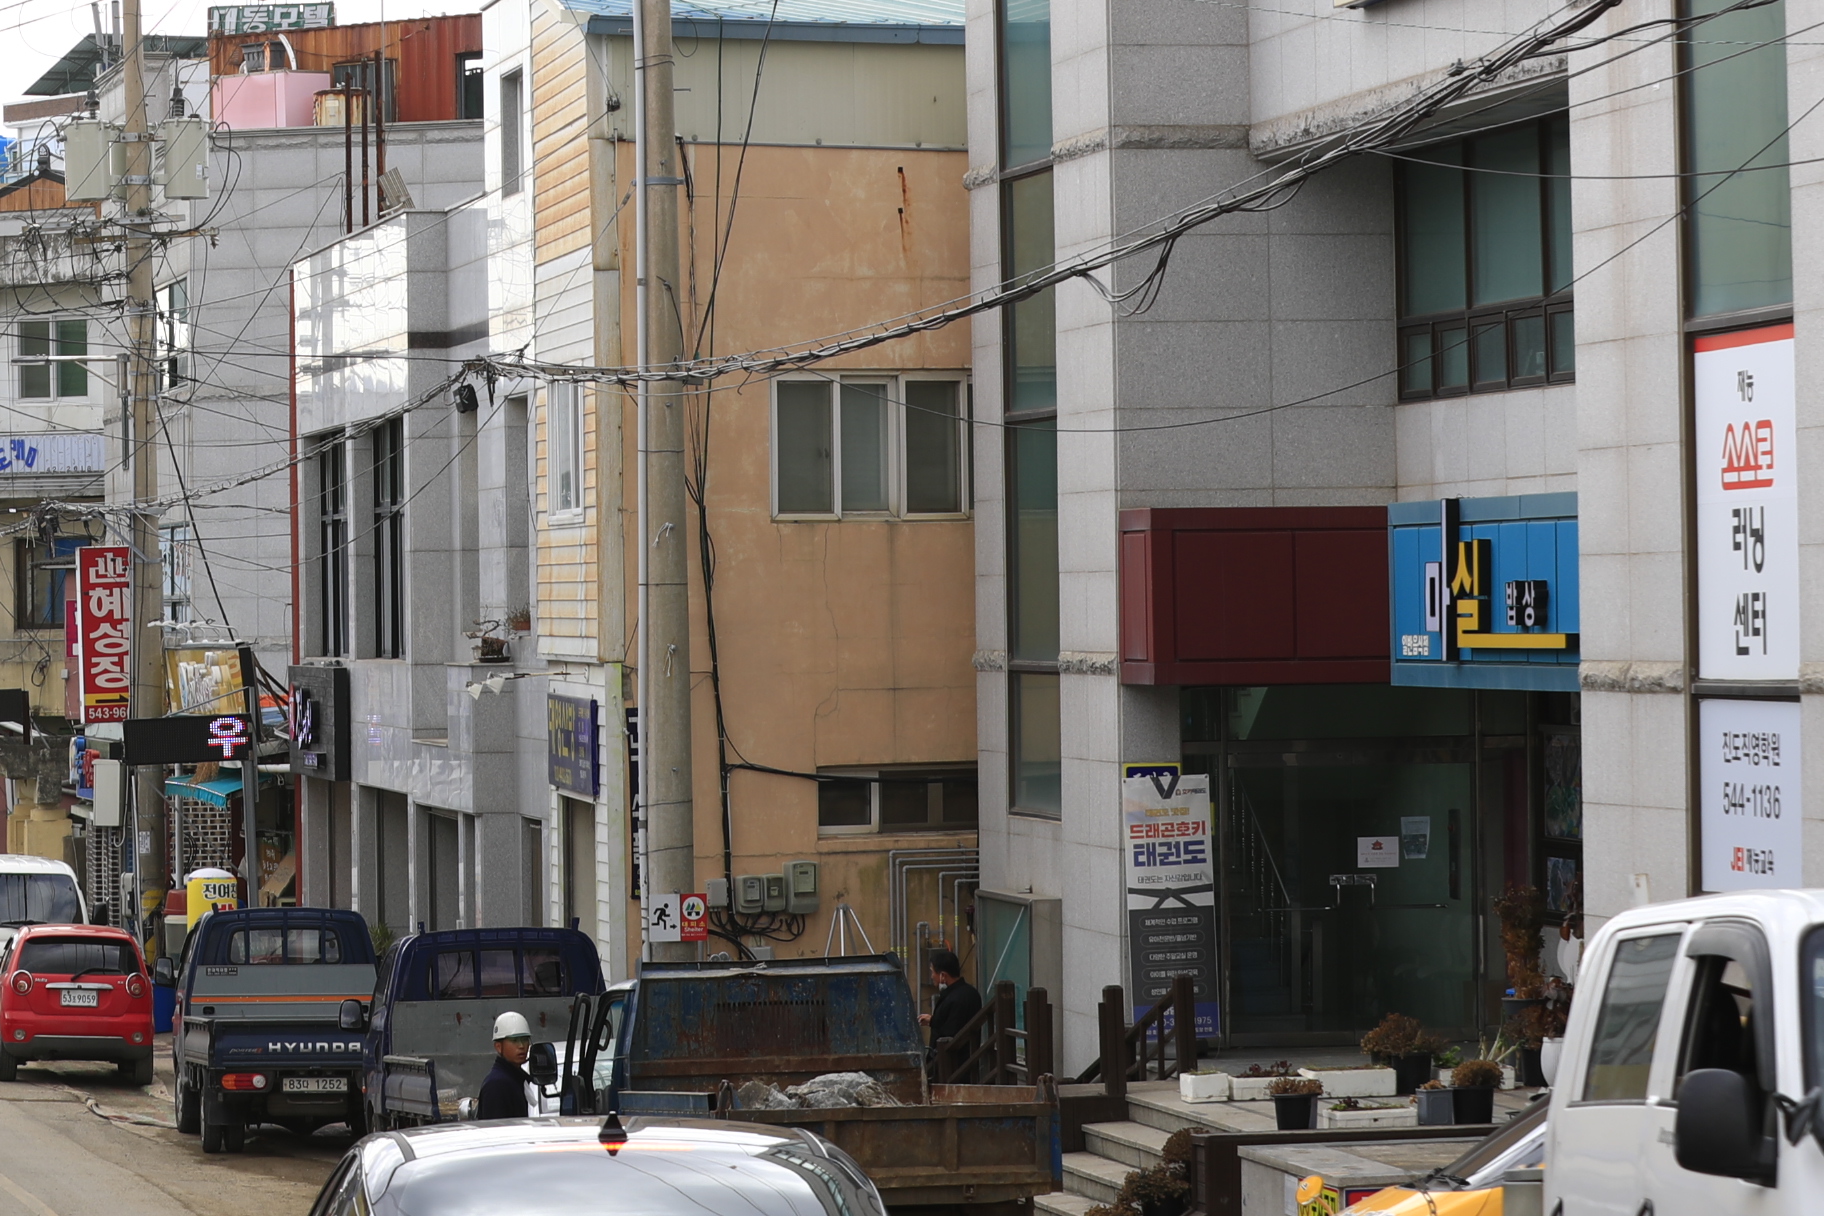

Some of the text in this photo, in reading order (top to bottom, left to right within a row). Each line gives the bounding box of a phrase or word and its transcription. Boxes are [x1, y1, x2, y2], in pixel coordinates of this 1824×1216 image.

[1736, 370, 1754, 403] 재능
[1732, 506, 1765, 573] 러닝
[1504, 580, 1537, 627] 밥상
[1734, 591, 1767, 656] 센터
[208, 717, 248, 759] 우
[1722, 731, 1781, 767] 진도직영학원
[1723, 781, 1781, 820] 544-1136
[1129, 820, 1206, 839] 드래곤호키
[1133, 840, 1207, 867] 태권도
[1746, 848, 1775, 876] 재능교육
[1138, 872, 1203, 884] 태권도는 자신감입니다
[315, 1079, 342, 1090] 1252
